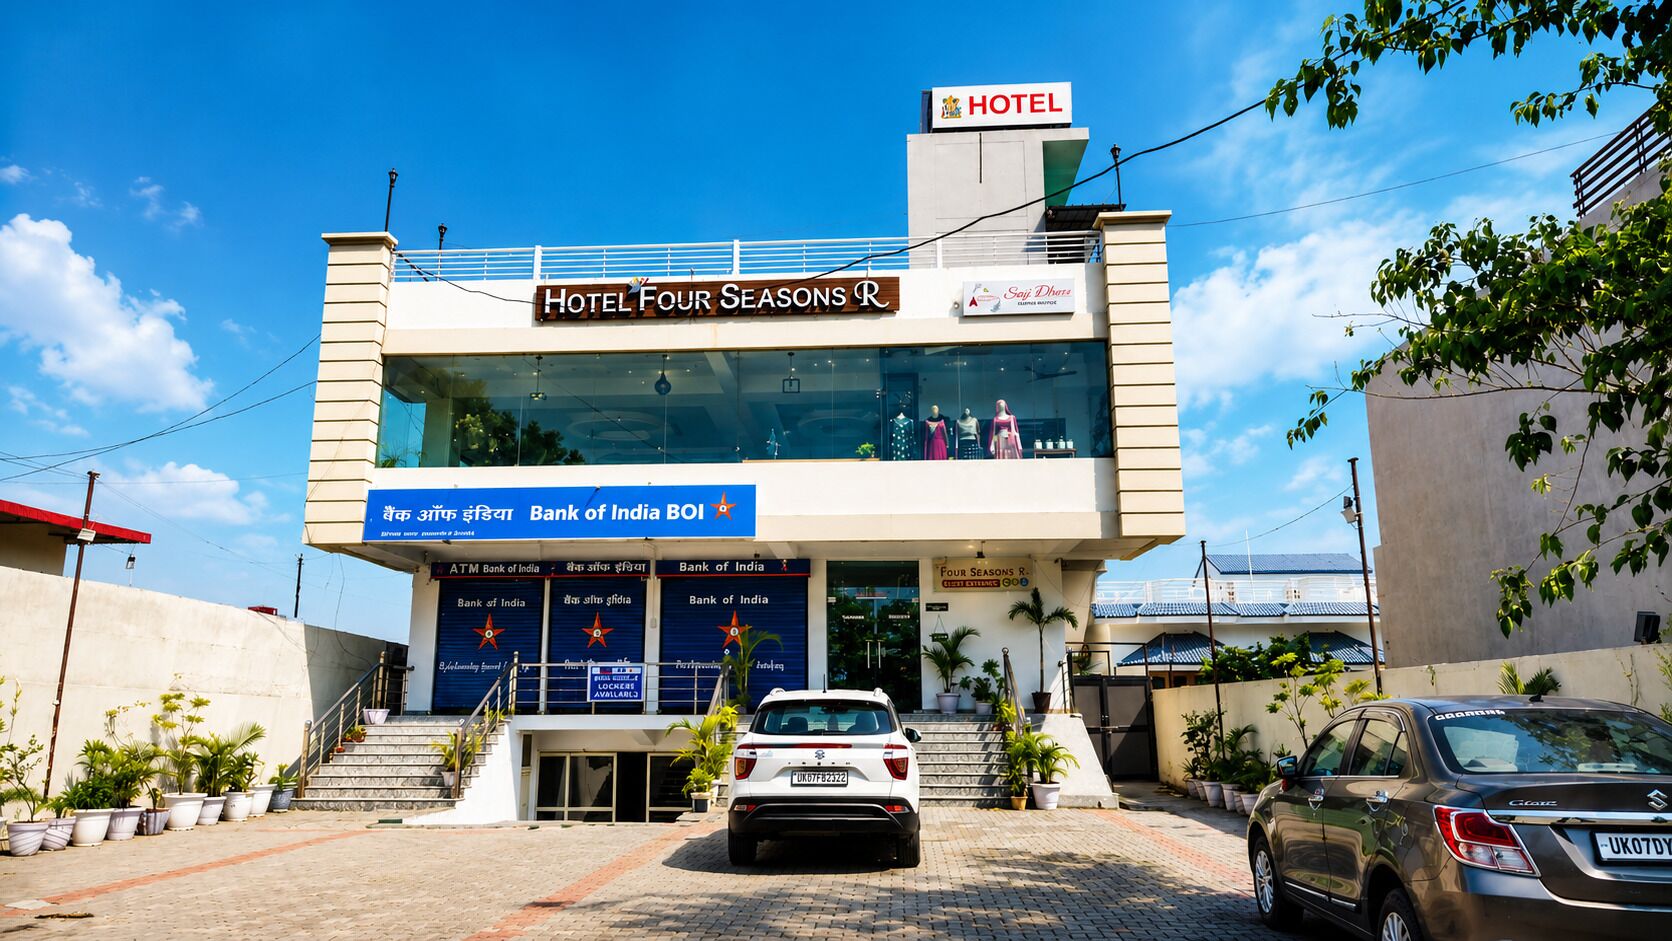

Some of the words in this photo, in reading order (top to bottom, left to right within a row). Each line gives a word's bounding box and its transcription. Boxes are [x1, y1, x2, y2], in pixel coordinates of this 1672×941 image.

[969, 93, 1063, 115] HOTEL
[545, 288, 632, 314] HOTEL
[639, 286, 711, 311] FOUR
[720, 283, 847, 310] SEASONS
[854, 280, 890, 309] R
[383, 505, 412, 522] बैंक
[462, 504, 514, 524] इंडिया
[529, 504, 580, 521] Bank
[584, 503, 607, 521] of
[611, 503, 660, 520] India
[667, 503, 704, 520] BOI
[450, 563, 479, 574] ATM
[483, 564, 505, 573] Bank
[508, 564, 517, 573] of
[518, 563, 540, 573] India
[679, 562, 709, 571] Bank
[715, 561, 729, 571] of
[736, 561, 765, 571] India
[940, 566, 966, 577] FOUR
[970, 567, 1014, 577] SEASONS
[457, 598, 483, 607] Bank
[501, 598, 526, 607] India
[689, 595, 717, 604] Bank
[722, 595, 734, 604] of
[740, 595, 769, 604] India
